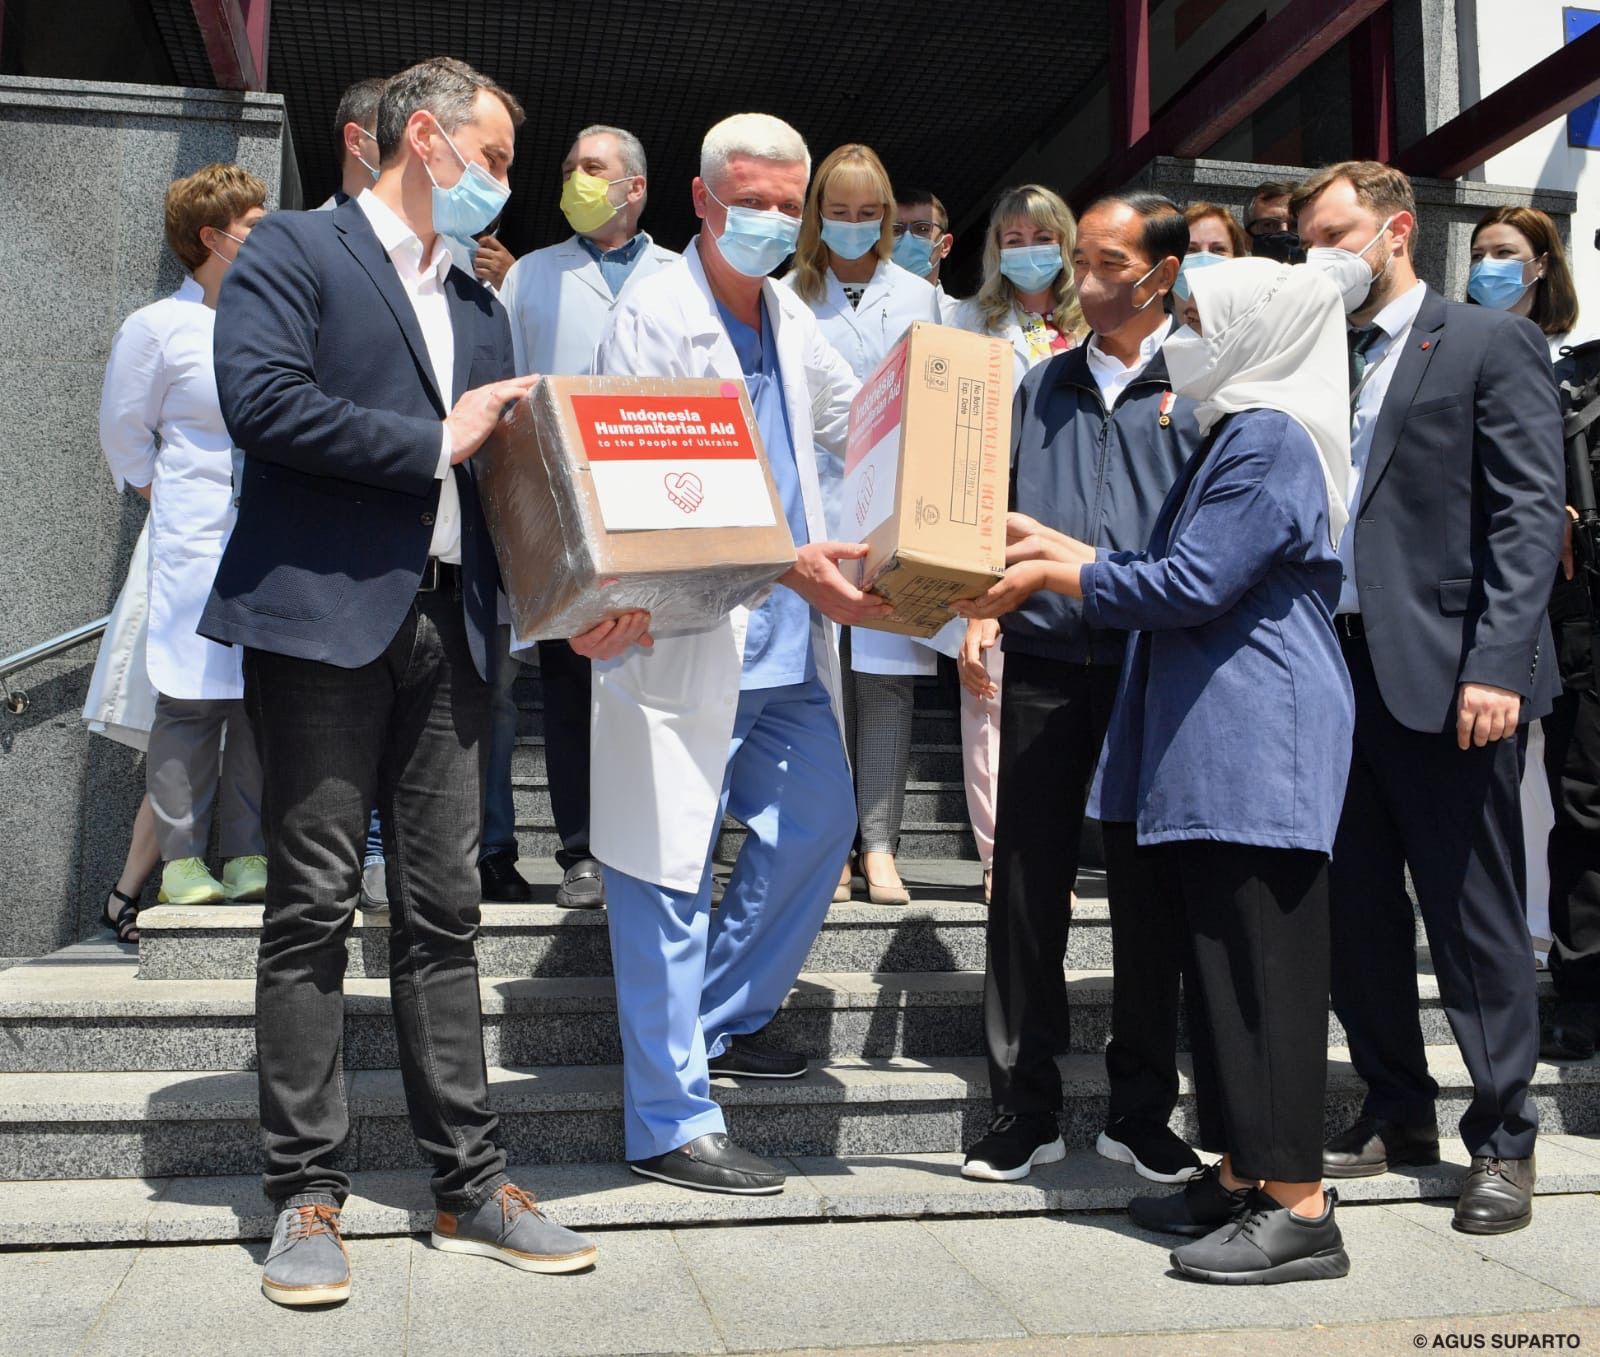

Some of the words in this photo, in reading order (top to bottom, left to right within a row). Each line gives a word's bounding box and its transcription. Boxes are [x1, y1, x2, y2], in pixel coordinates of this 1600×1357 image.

[888, 379, 901, 403] Aid
[973, 384, 981, 394] No
[960, 398, 969, 415] Date
[972, 396, 981, 416] Batch
[619, 408, 701, 422] Indonesia
[594, 421, 707, 435] Humanitarian
[710, 422, 736, 435] Aid
[598, 439, 610, 447] to
[614, 439, 634, 447] the
[639, 439, 677, 448] People
[682, 439, 693, 447] of
[697, 439, 739, 447] Ukraine
